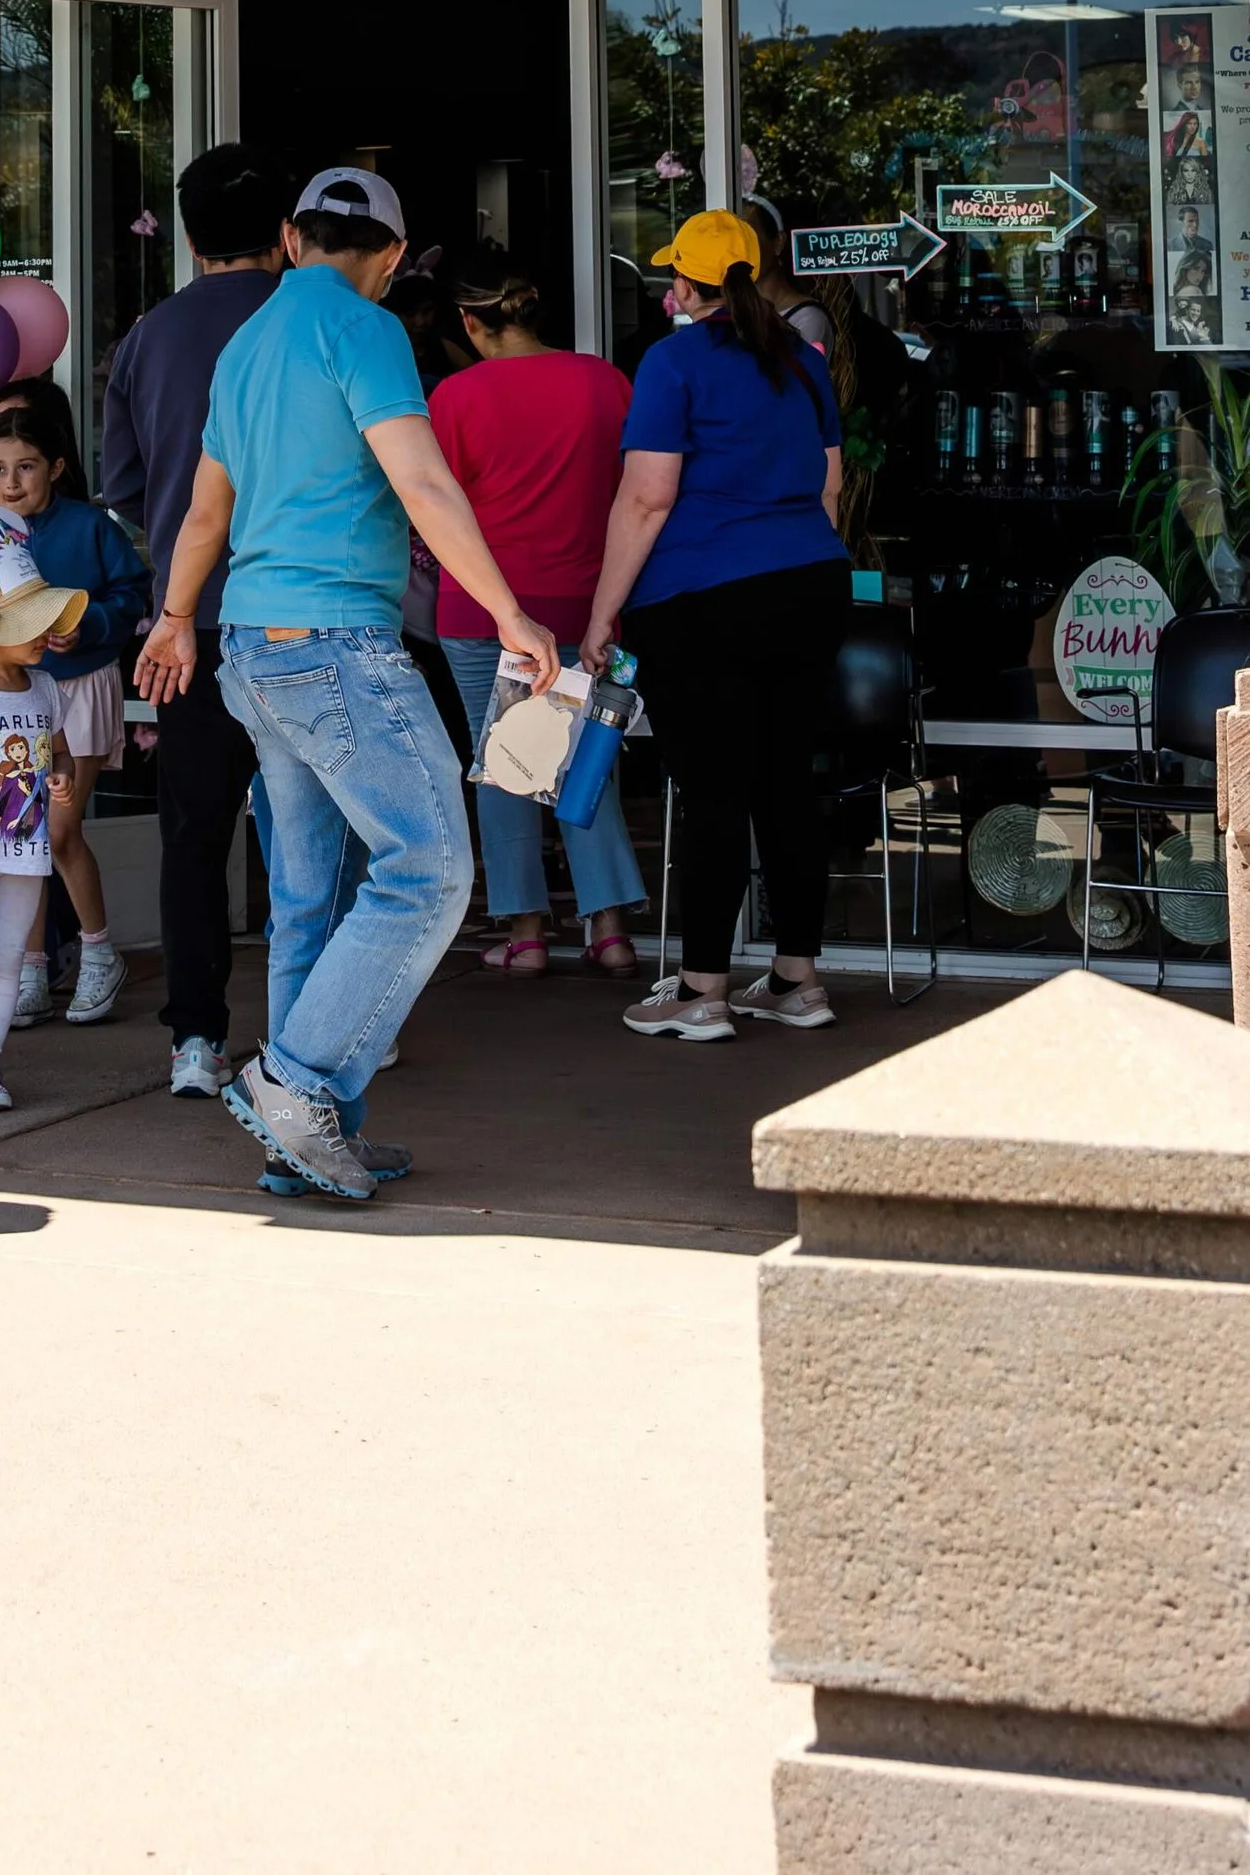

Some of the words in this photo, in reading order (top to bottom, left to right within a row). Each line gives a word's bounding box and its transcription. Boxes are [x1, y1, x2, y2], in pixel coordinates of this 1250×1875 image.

[970, 190, 1016, 204] SALE
[1020, 215, 1044, 225] OFF
[840, 247, 869, 265] 25%
[1074, 593, 1162, 623] Every
[1061, 621, 1164, 658] Bunn
[1078, 672, 1153, 692] WELCOM
